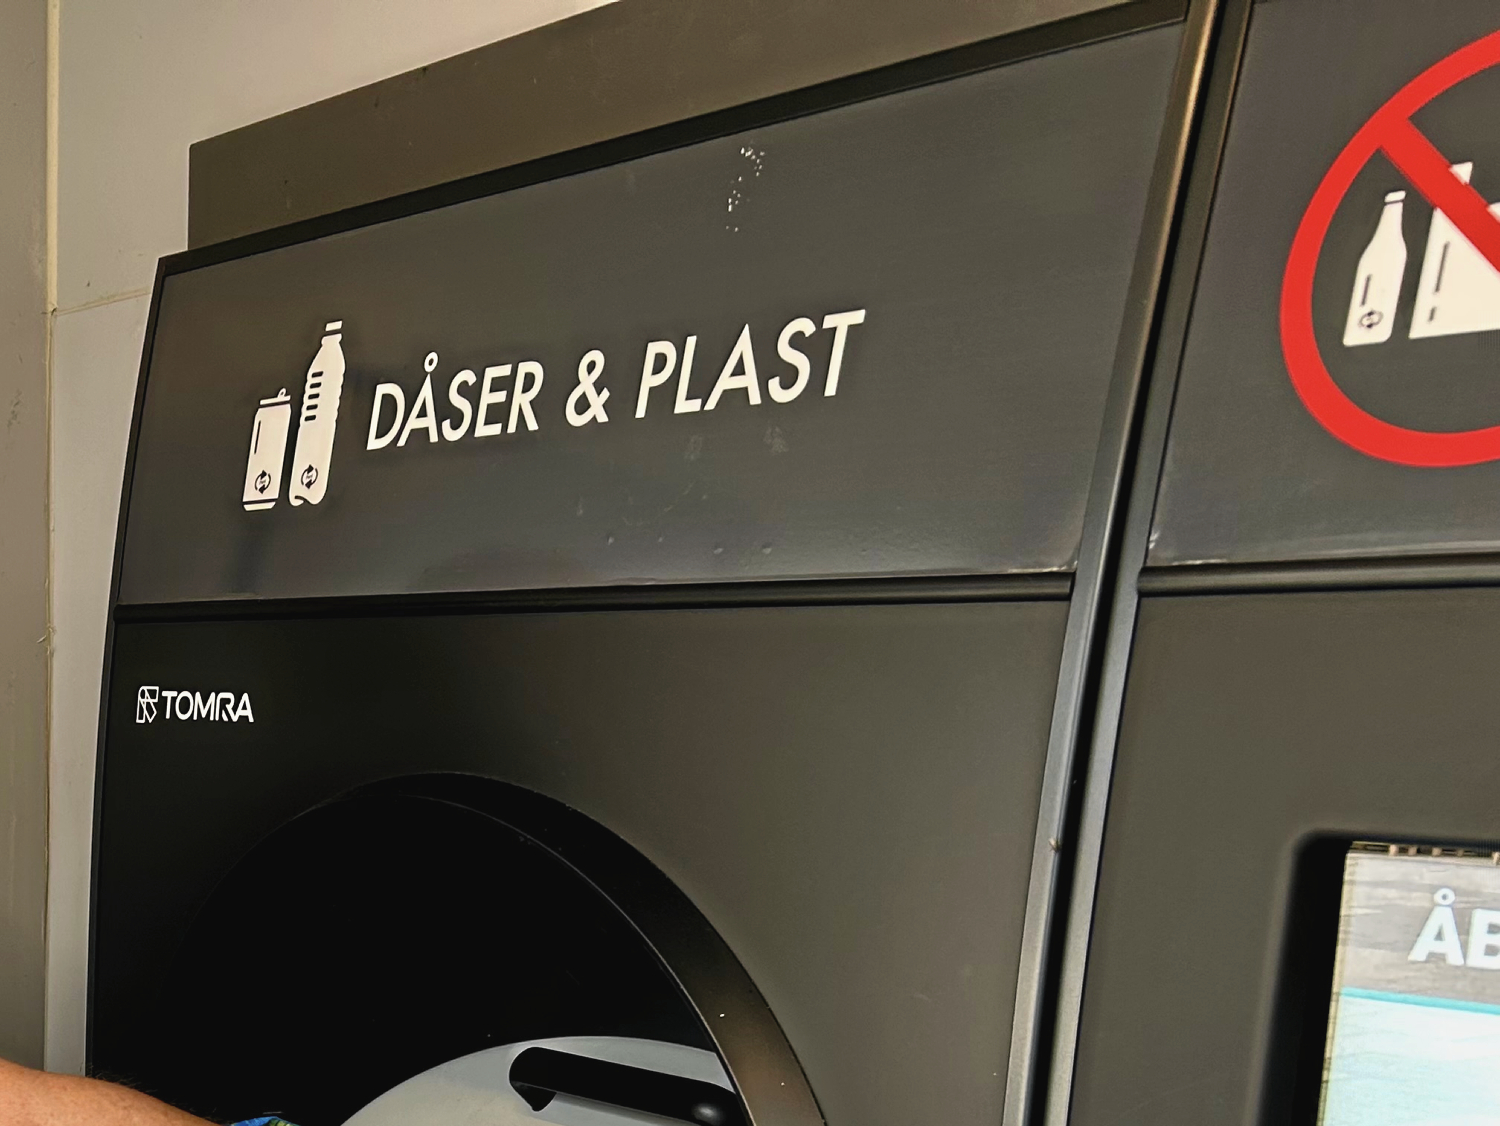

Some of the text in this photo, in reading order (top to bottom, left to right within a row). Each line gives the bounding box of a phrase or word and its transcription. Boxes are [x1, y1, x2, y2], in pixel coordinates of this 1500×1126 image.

[367, 308, 866, 451] DÅSER & PLAST
[161, 690, 255, 723] TOMRA
